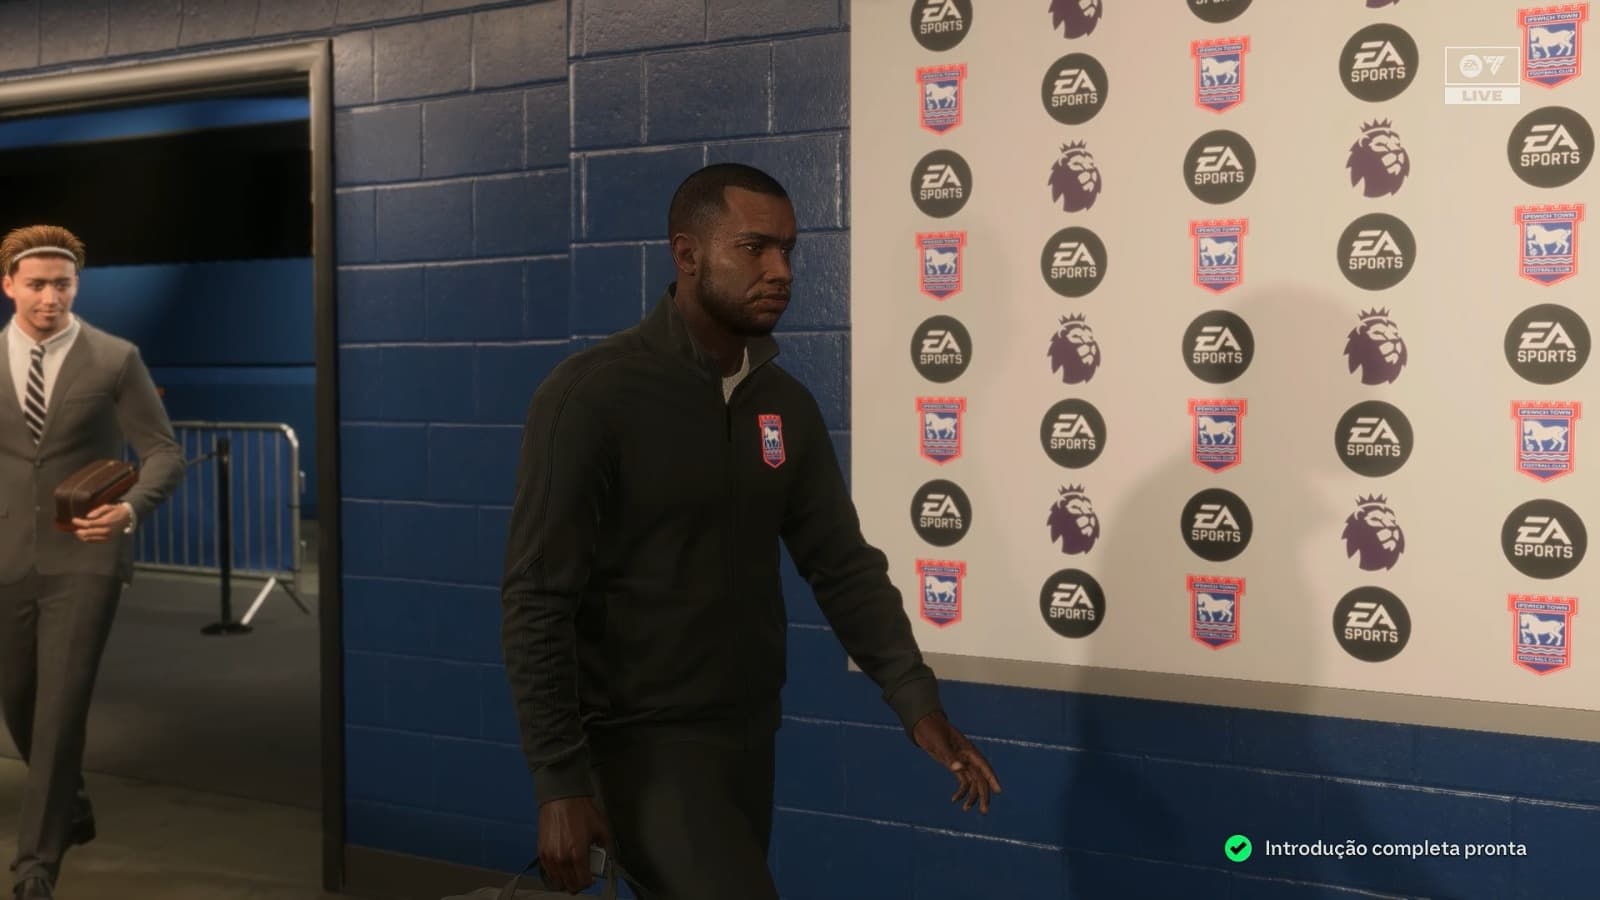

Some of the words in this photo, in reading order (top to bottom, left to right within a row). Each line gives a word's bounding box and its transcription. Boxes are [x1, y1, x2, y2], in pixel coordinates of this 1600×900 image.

[921, 0, 962, 23] EA
[920, 20, 963, 34] SPORTS
[1352, 41, 1404, 69] EA
[1053, 69, 1096, 95] EA
[1351, 66, 1405, 82] SPORTS
[1052, 92, 1098, 107] SPORTS
[1522, 124, 1579, 153] EA
[1195, 146, 1243, 173] EA
[1521, 151, 1580, 167] SPORTS
[921, 164, 961, 189] EA
[1194, 171, 1244, 185] SPORTS
[920, 187, 962, 200] SPORTS
[1350, 230, 1402, 257] EA
[1052, 242, 1096, 267] EA
[1349, 256, 1403, 270] SPORTS
[1051, 266, 1097, 279] SPORTS
[921, 330, 961, 354] EA
[1194, 326, 1241, 352] EA
[1519, 322, 1575, 349] EA
[920, 353, 962, 364] SPORTS
[1193, 352, 1242, 364] SPORTS
[1517, 350, 1576, 362] SPORTS
[1051, 414, 1095, 438] EA
[1348, 417, 1399, 444] EA
[1050, 438, 1096, 450] SPORTS
[1347, 444, 1401, 457] SPORTS
[921, 494, 961, 518] EA
[920, 517, 962, 529] SPORTS
[1193, 504, 1239, 530] EA
[1192, 529, 1241, 542] SPORTS
[1516, 516, 1572, 545] EA
[1514, 544, 1573, 558] SPORTS
[1051, 583, 1093, 609] EA
[1050, 606, 1095, 620] SPORTS
[1346, 602, 1397, 630] EA
[1345, 628, 1398, 643] SPORTS
